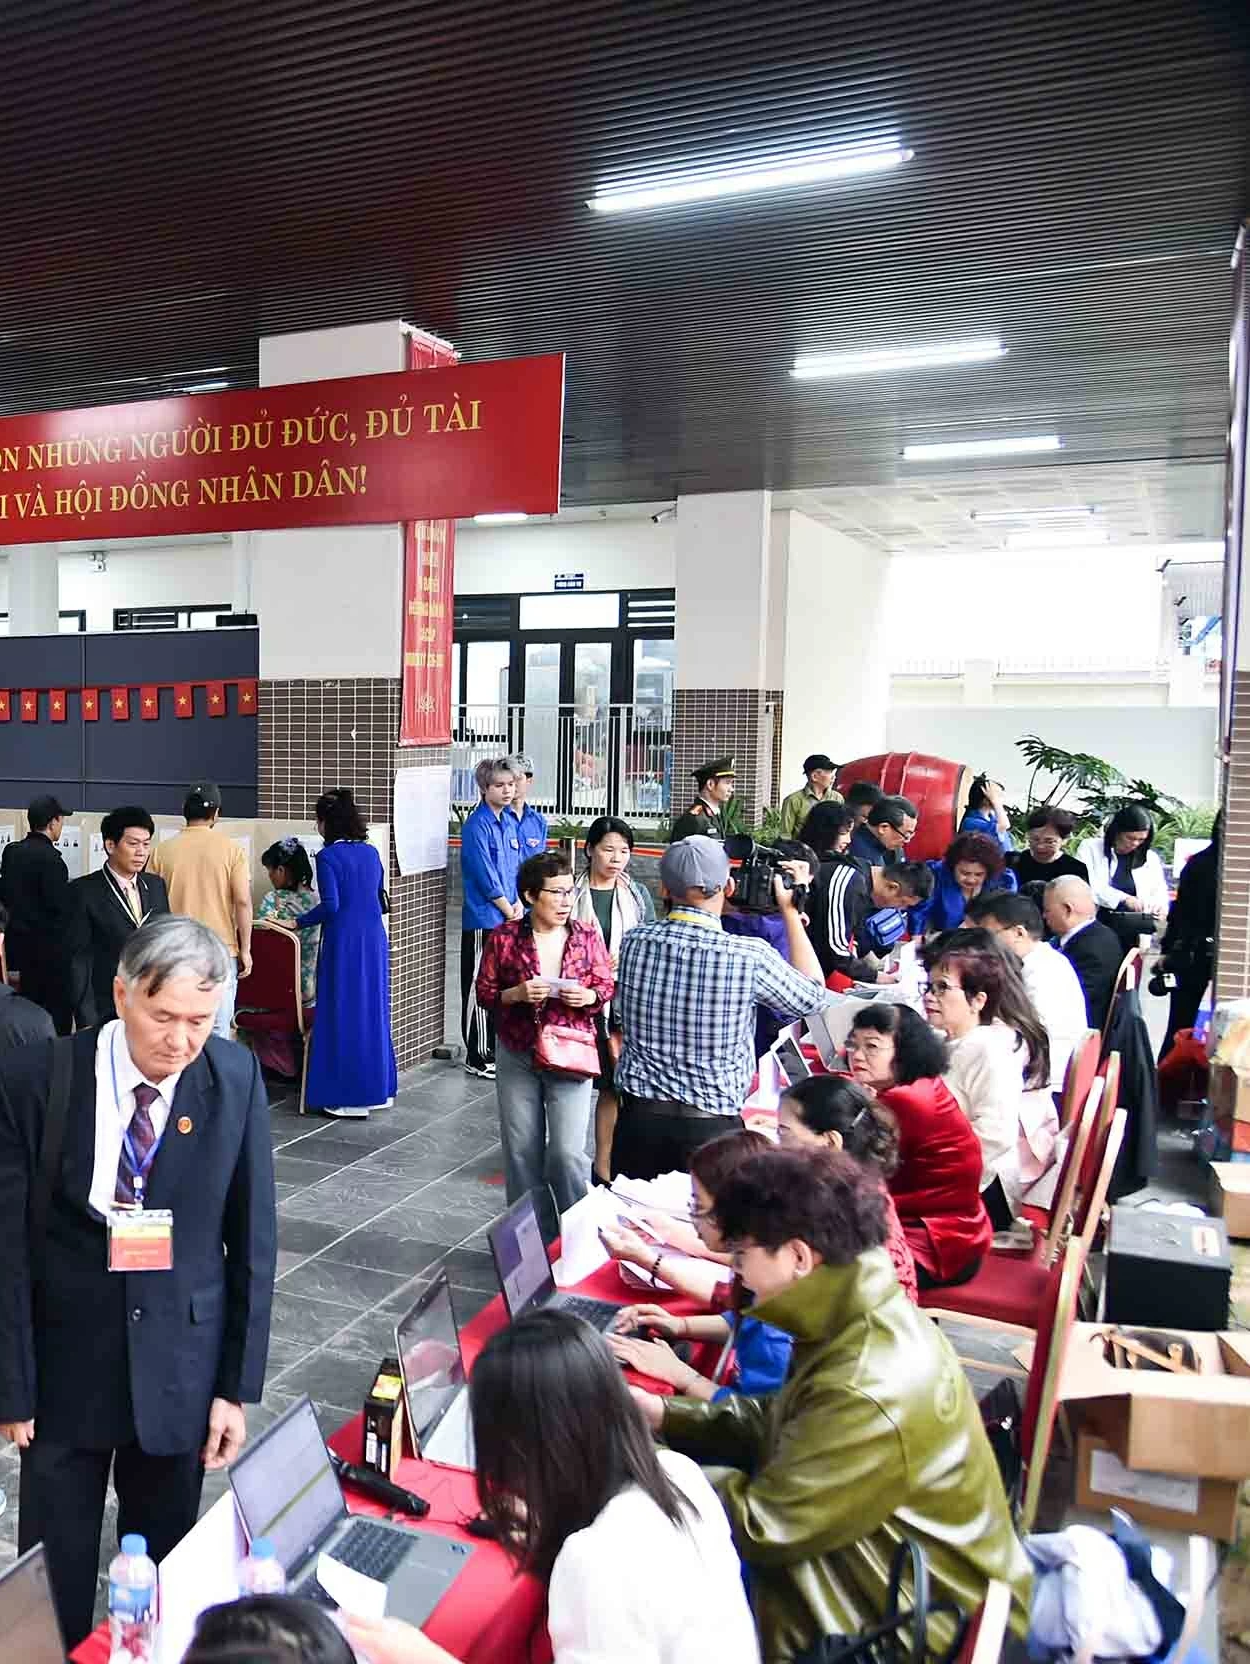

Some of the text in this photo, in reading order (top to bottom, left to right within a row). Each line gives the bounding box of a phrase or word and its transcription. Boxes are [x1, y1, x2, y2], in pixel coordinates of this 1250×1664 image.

[26, 431, 121, 470] NHỮNG
[130, 416, 223, 461] NGƯỜI
[230, 409, 273, 450] ĐỦ
[282, 407, 356, 446] ĐỨC,
[366, 394, 414, 438] ĐỦ
[424, 393, 481, 432] TÀI
[14, 483, 48, 518] VÀ
[54, 480, 102, 520] HỘI
[110, 470, 190, 510] ĐỒNG
[198, 466, 283, 504] NHÂN
[292, 460, 366, 497] DÂN!
